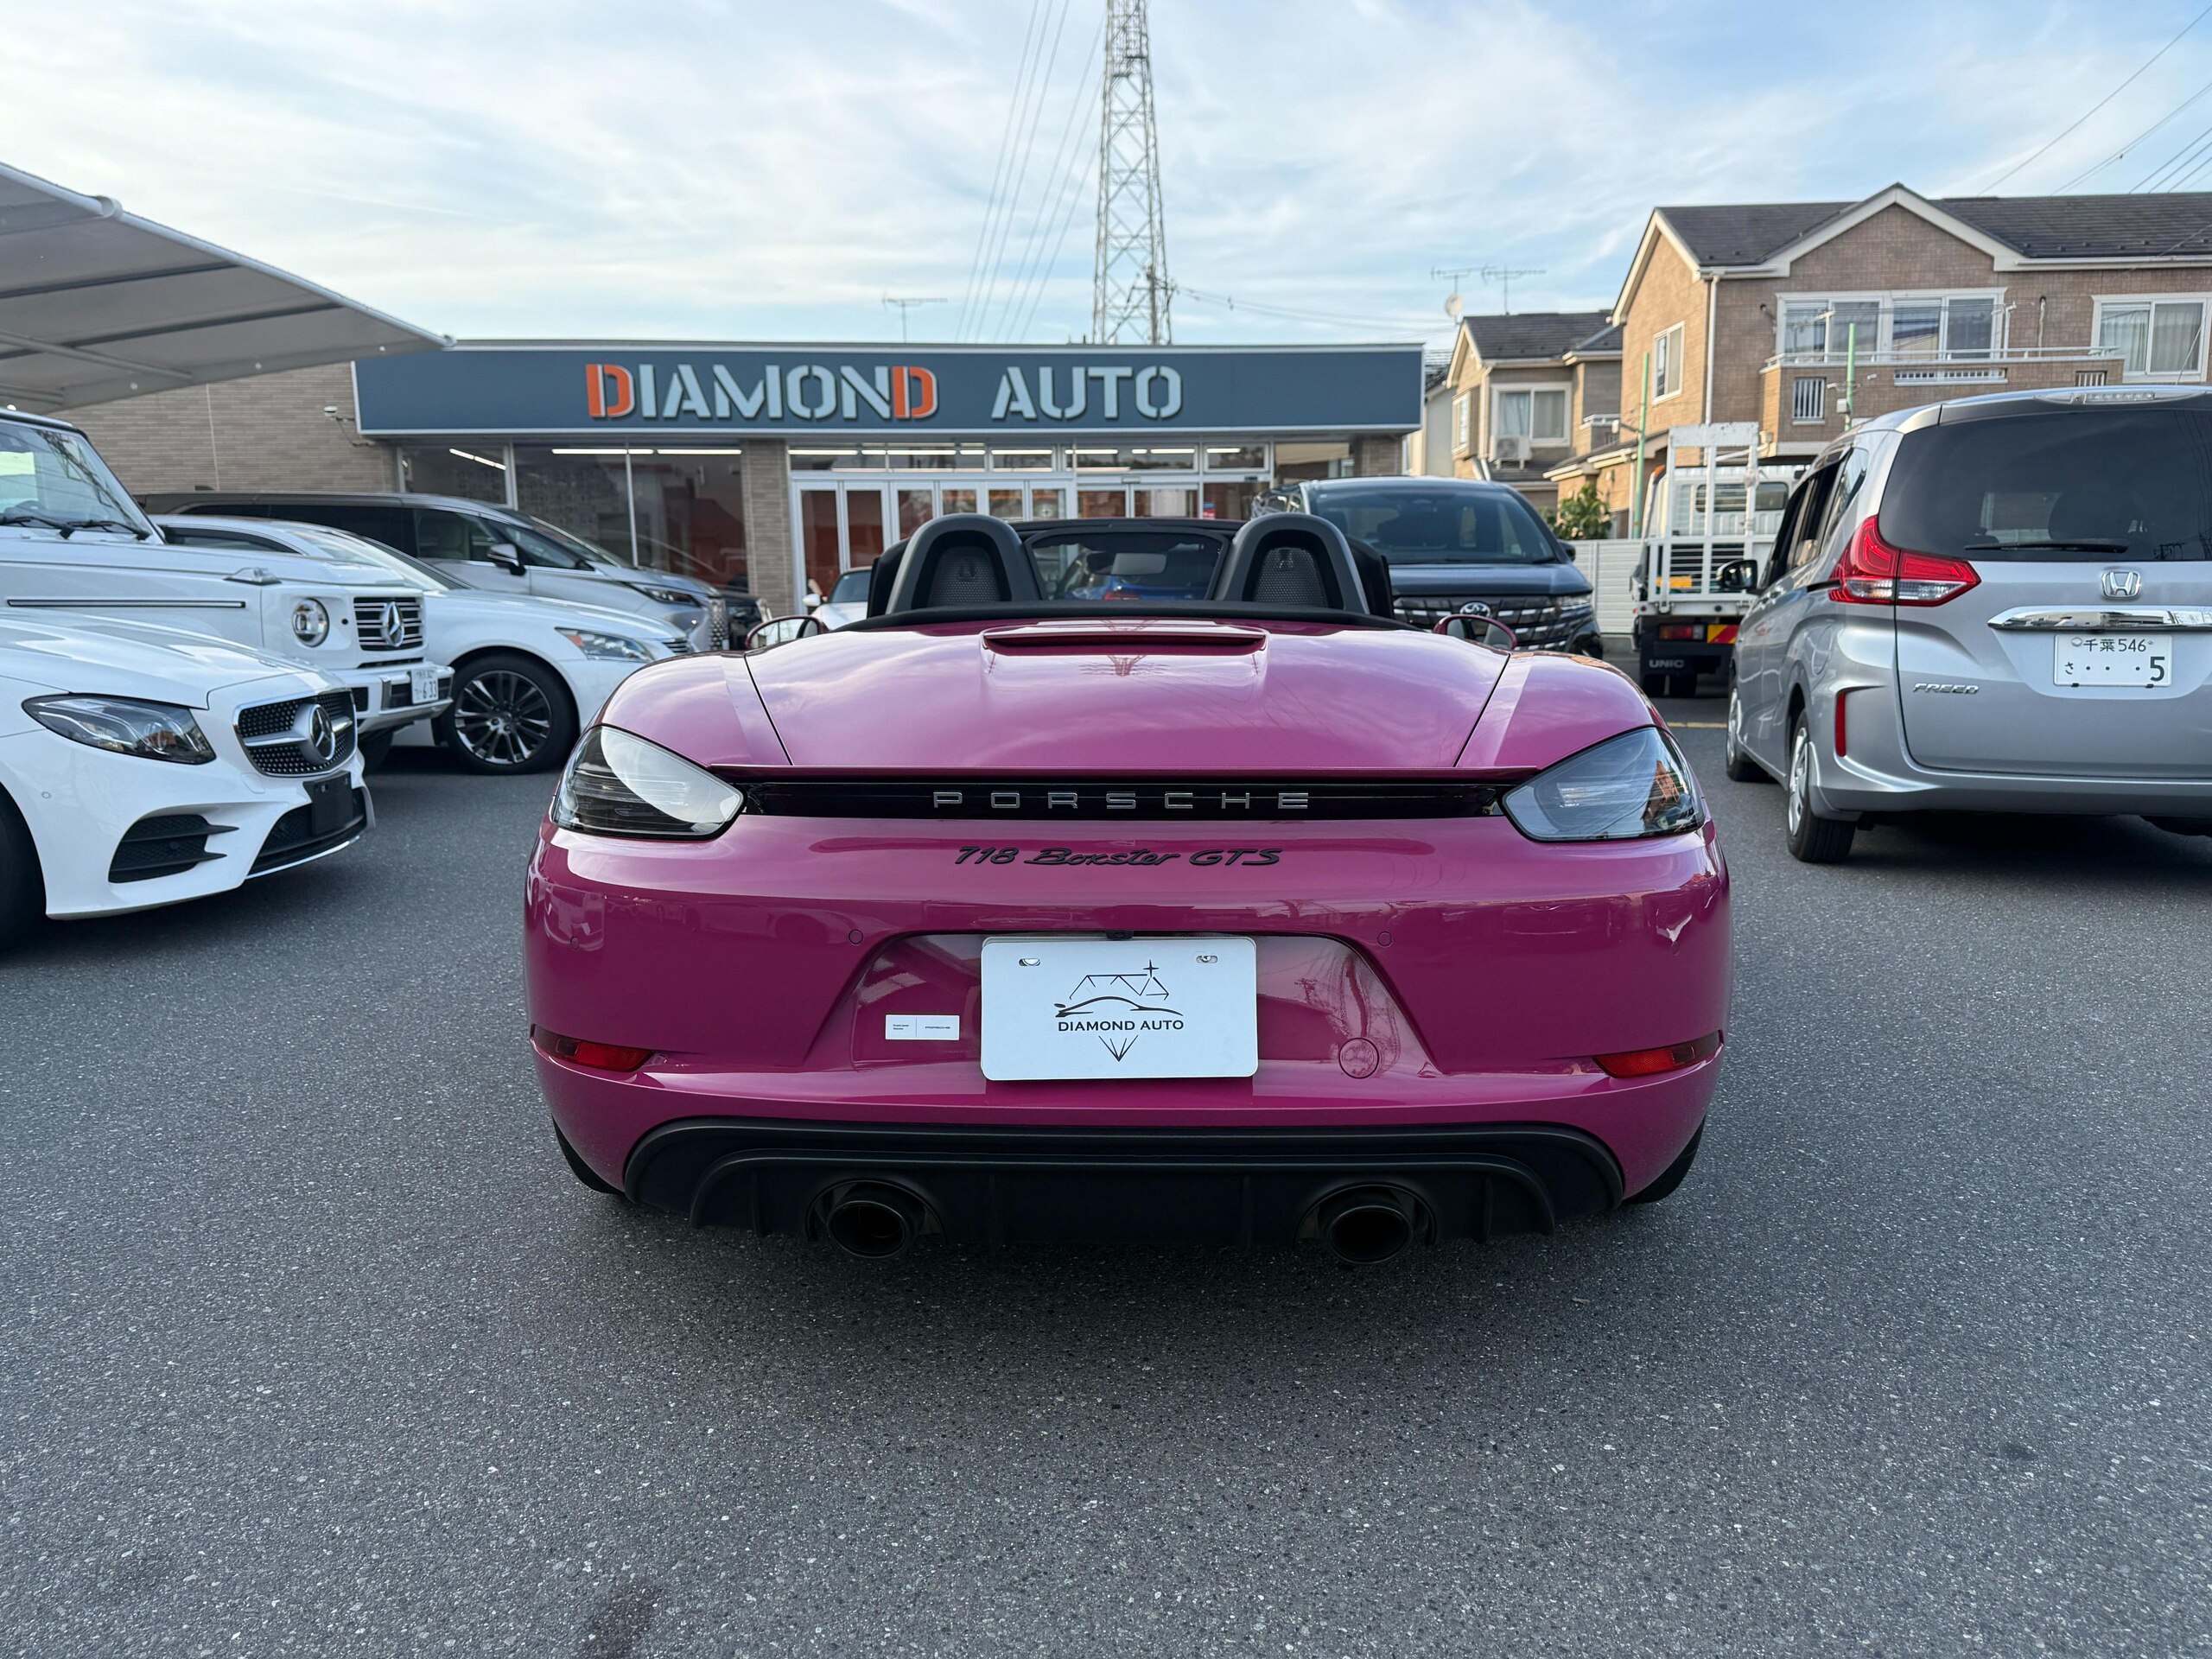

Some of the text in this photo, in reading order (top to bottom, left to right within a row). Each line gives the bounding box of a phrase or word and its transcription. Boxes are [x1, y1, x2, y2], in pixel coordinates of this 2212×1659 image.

[586, 364, 1182, 419] DIAMOND AUTO
[1649, 659, 1685, 669] UNIC
[1913, 683, 1980, 695] FREED
[933, 791, 1309, 810] PORSCHE
[955, 846, 1283, 866] 718 Boxster GTS
[1058, 1020, 1185, 1032] DIAMOND AUTO
